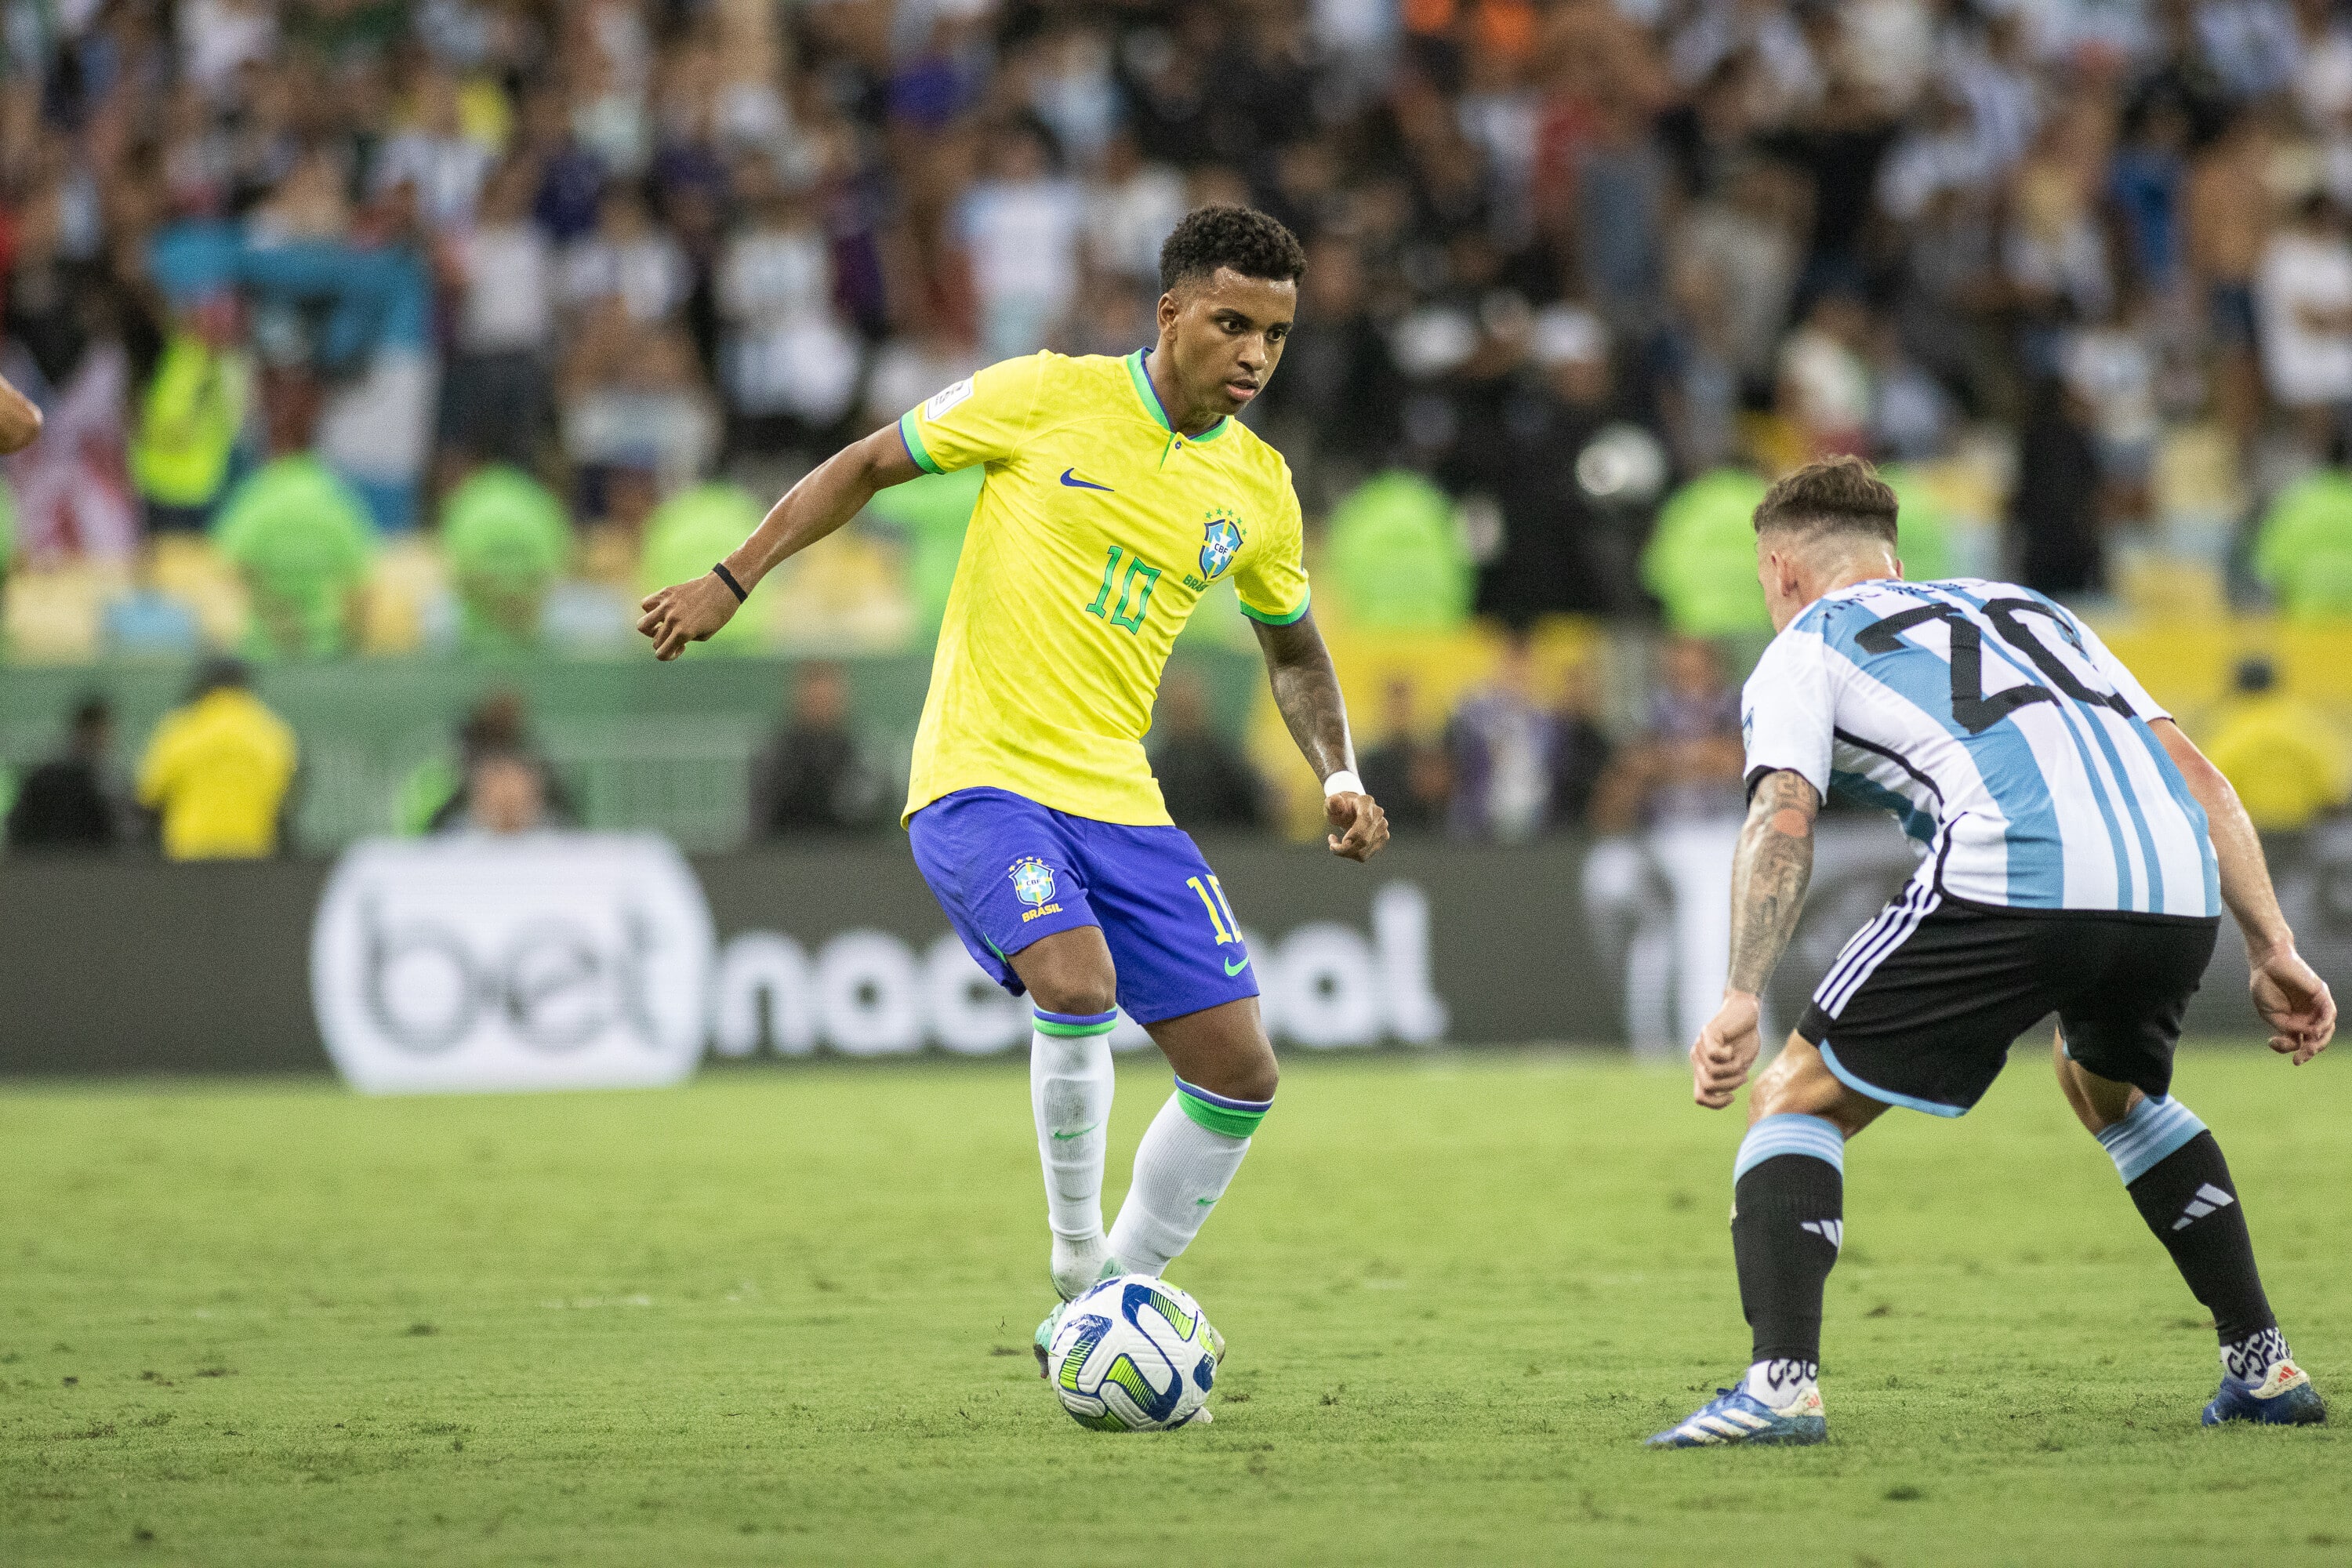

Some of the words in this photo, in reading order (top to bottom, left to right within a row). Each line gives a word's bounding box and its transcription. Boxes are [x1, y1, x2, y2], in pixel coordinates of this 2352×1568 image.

[1214, 543, 1229, 555] CBF
[1085, 545, 1163, 636] 10
[1182, 573, 1209, 593] BRA
[1853, 597, 2139, 735] 20
[1022, 902, 1064, 923] BRASIL
